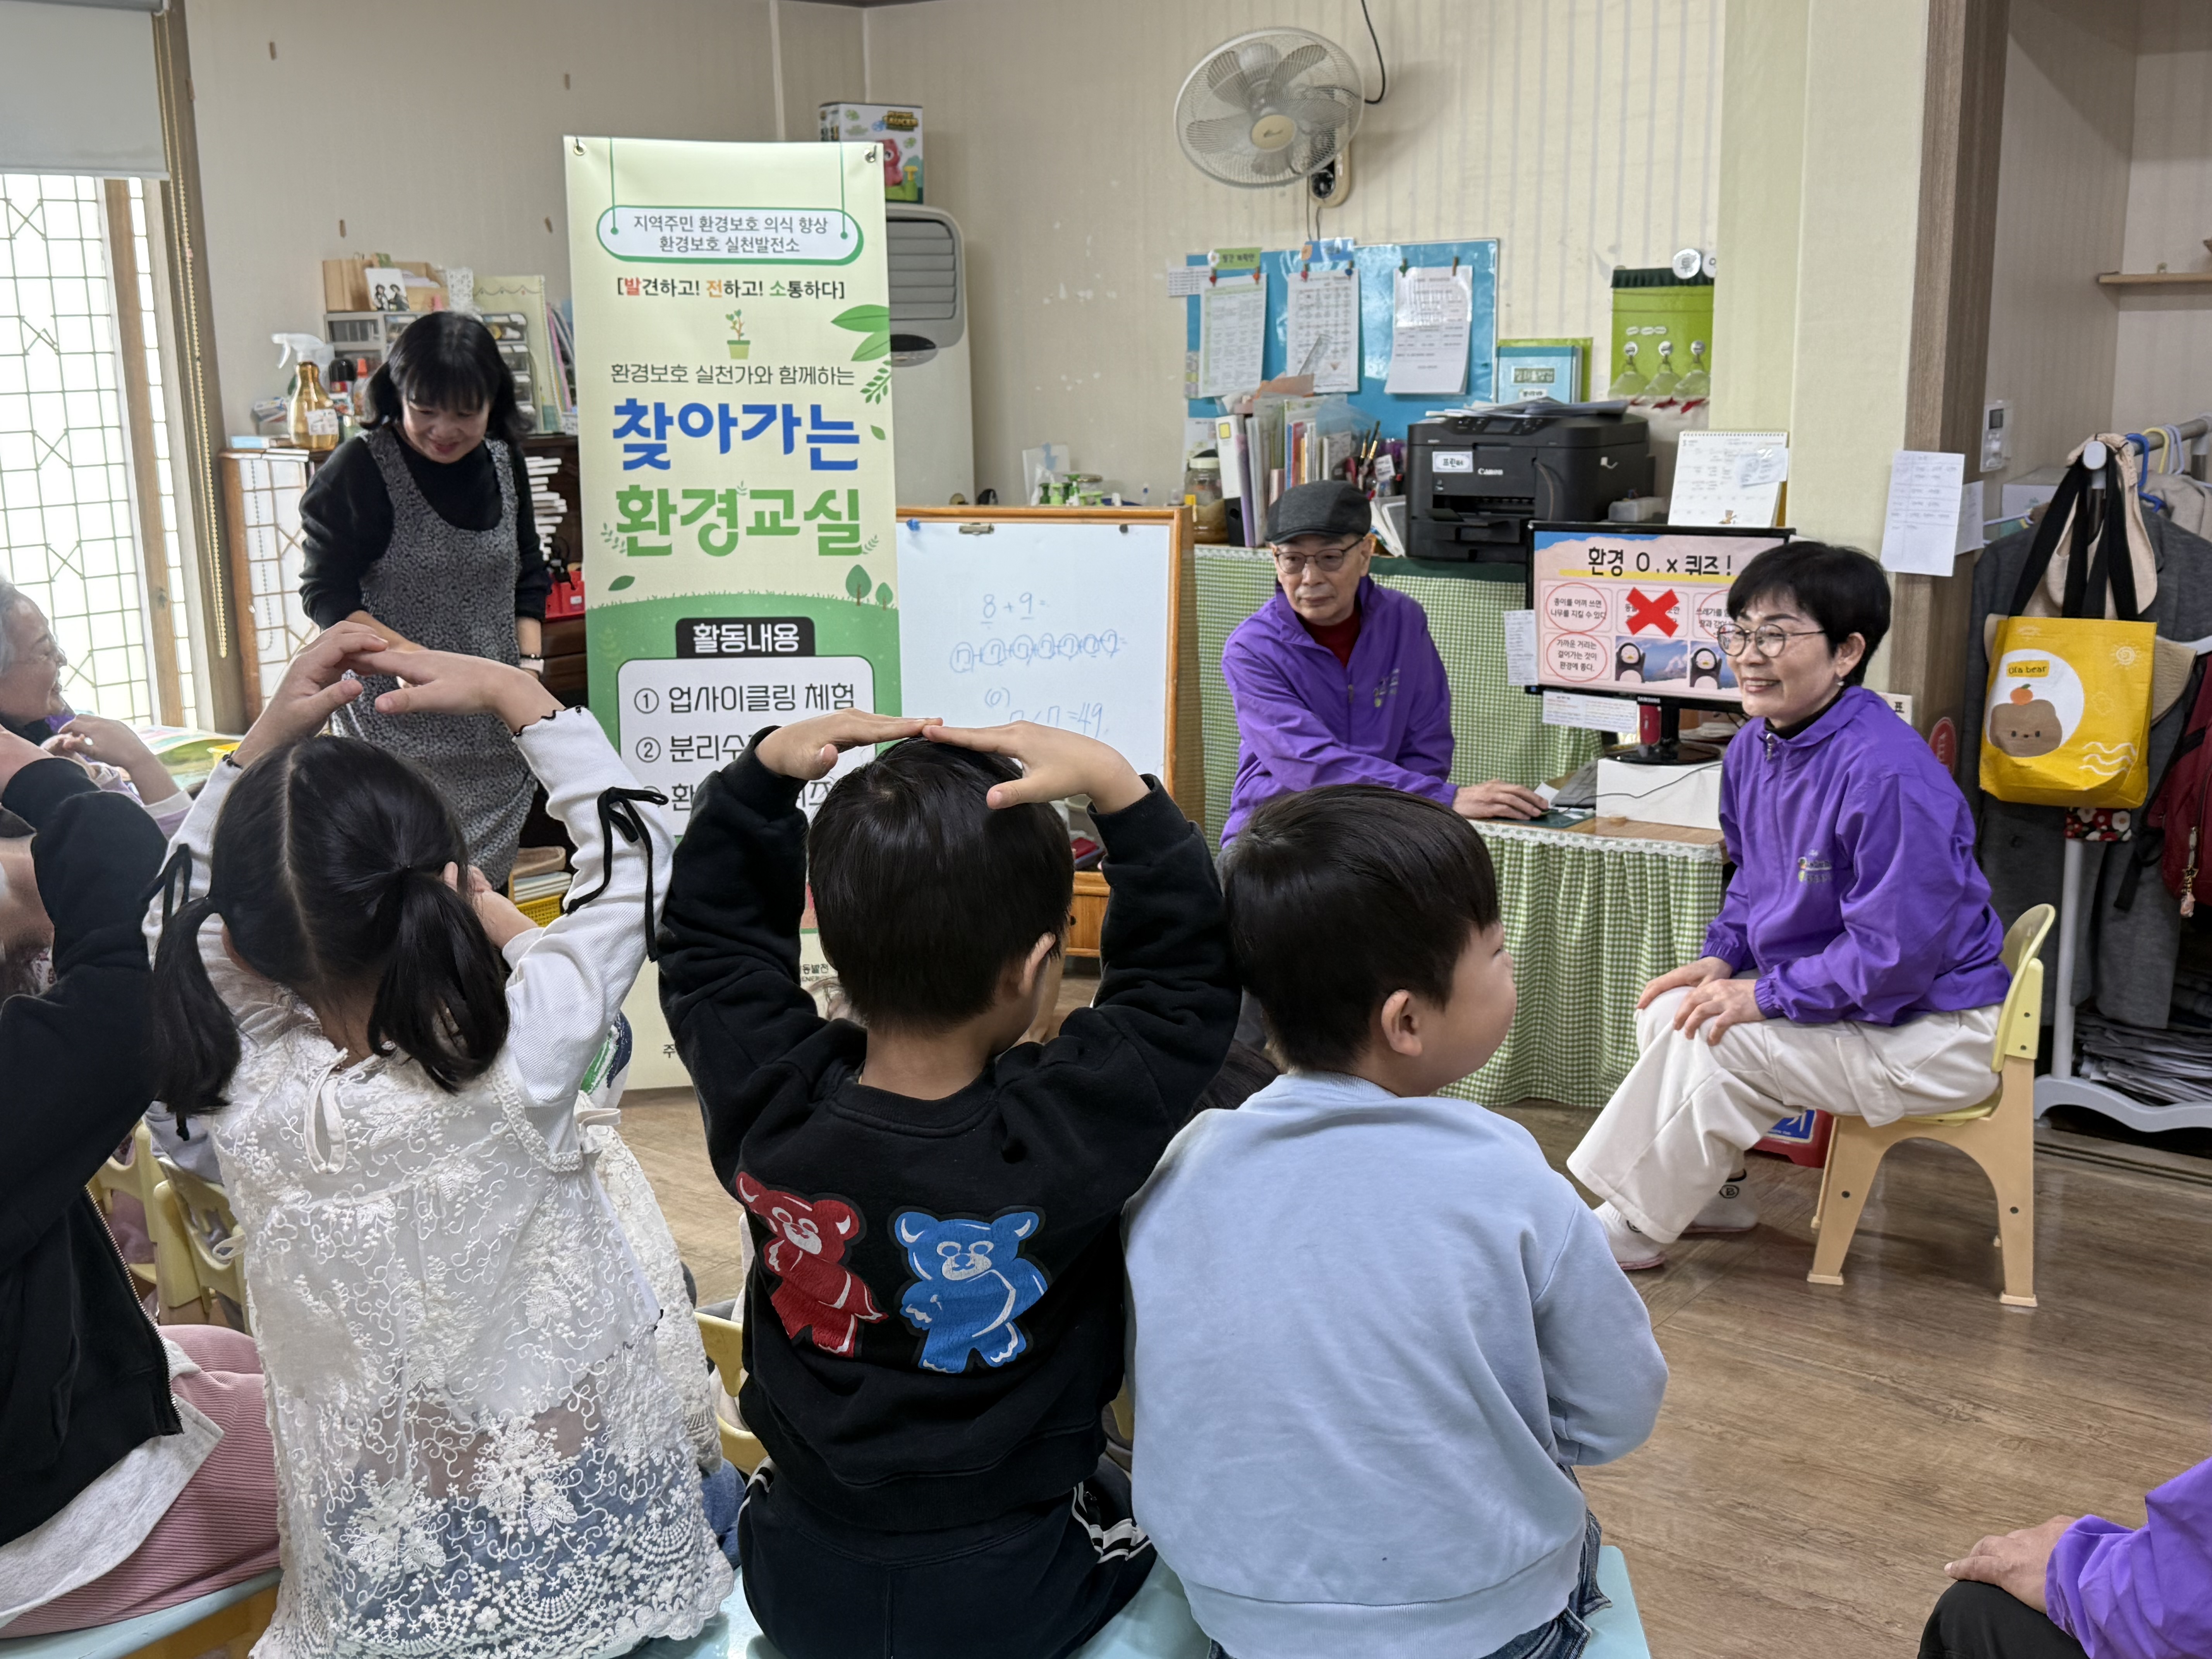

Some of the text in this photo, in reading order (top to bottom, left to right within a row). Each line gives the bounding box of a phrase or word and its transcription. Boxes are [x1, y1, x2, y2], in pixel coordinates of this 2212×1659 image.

[634, 215, 828, 234] 지역주민 환경보호 의식 향상
[659, 236, 800, 253] 환경보호 실천발전소
[617, 278, 845, 299] [발견하고! 전하고! 소통하다]
[611, 364, 854, 386] 환경보호 실천가와 함께하는
[613, 398, 860, 471] 찾아가는
[616, 484, 862, 556] 환경교실
[1589, 547, 1623, 576] 환경
[1554, 598, 1573, 606] 종이를
[1589, 600, 1602, 608] 쓰면
[1551, 609, 1569, 617] 나무를
[1571, 610, 1583, 618] 지킬
[693, 623, 799, 654] 활동내용
[1556, 639, 1597, 650] 가까운 거리는
[1558, 651, 1597, 661] 걸어가는 것이
[1560, 661, 1595, 672] 환경에 좋다.
[668, 685, 795, 713] 업사이클링
[805, 682, 854, 710] 체험
[670, 734, 754, 762] 분리수
[800, 963, 828, 975] 동발전
